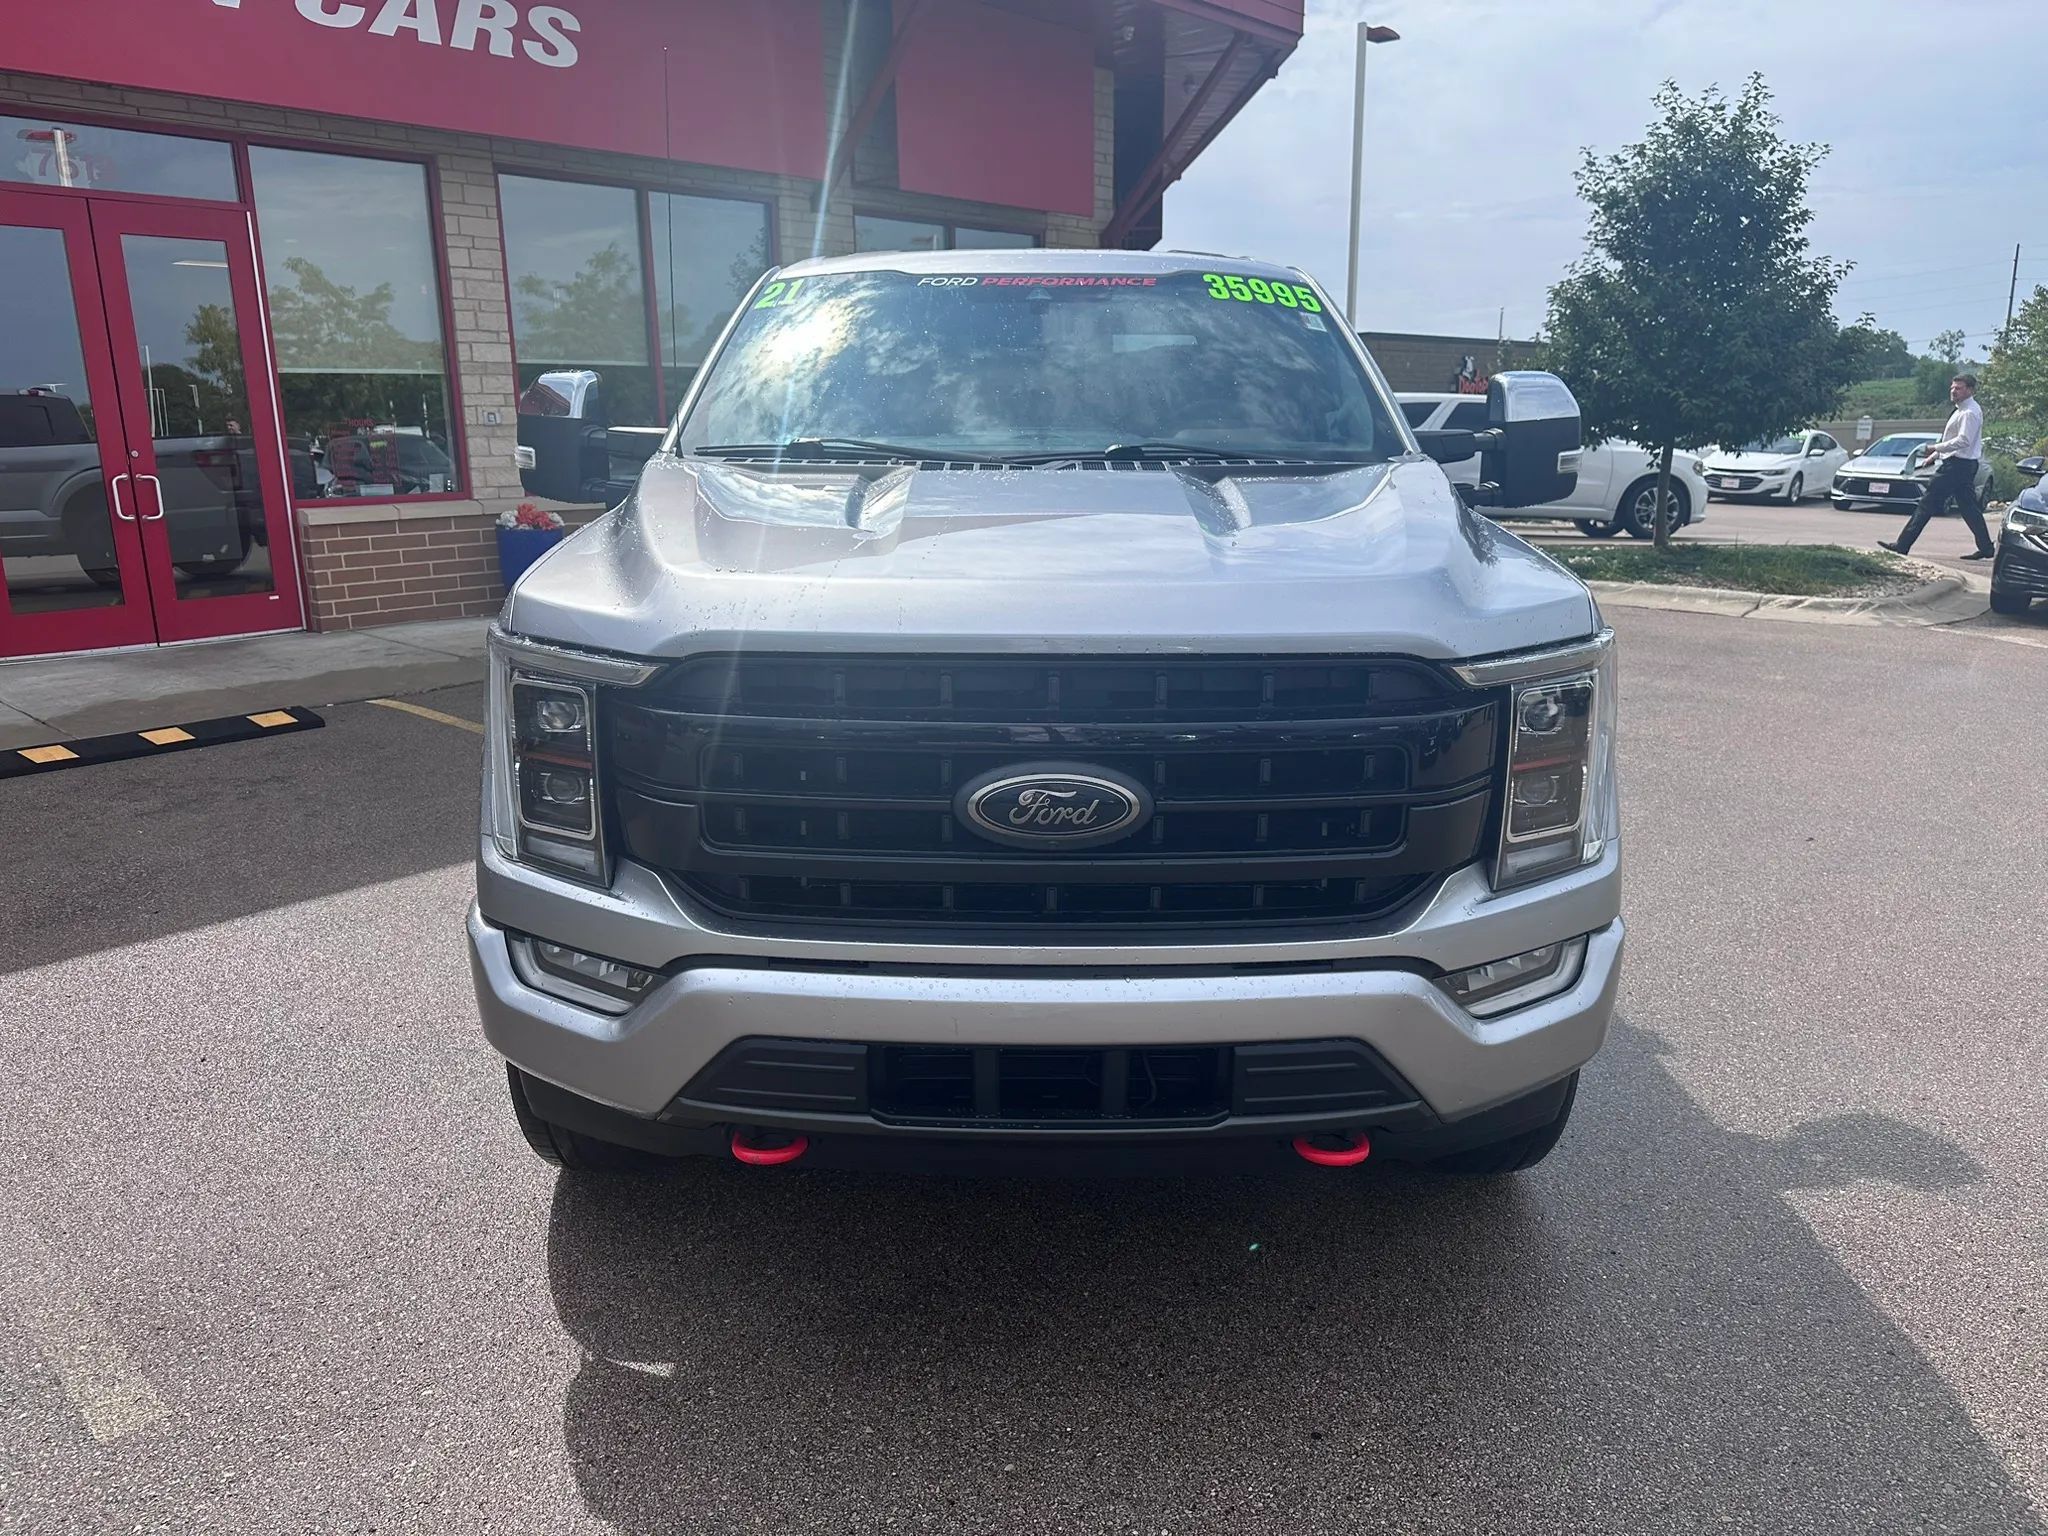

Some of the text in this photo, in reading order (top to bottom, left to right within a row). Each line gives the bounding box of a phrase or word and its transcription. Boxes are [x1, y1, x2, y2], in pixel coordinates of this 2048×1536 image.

[754, 279, 805, 310] 21
[917, 276, 1157, 287] FORD PERFORMANCE
[1202, 273, 1322, 313] 35995
[1009, 789, 1099, 825] Ford
